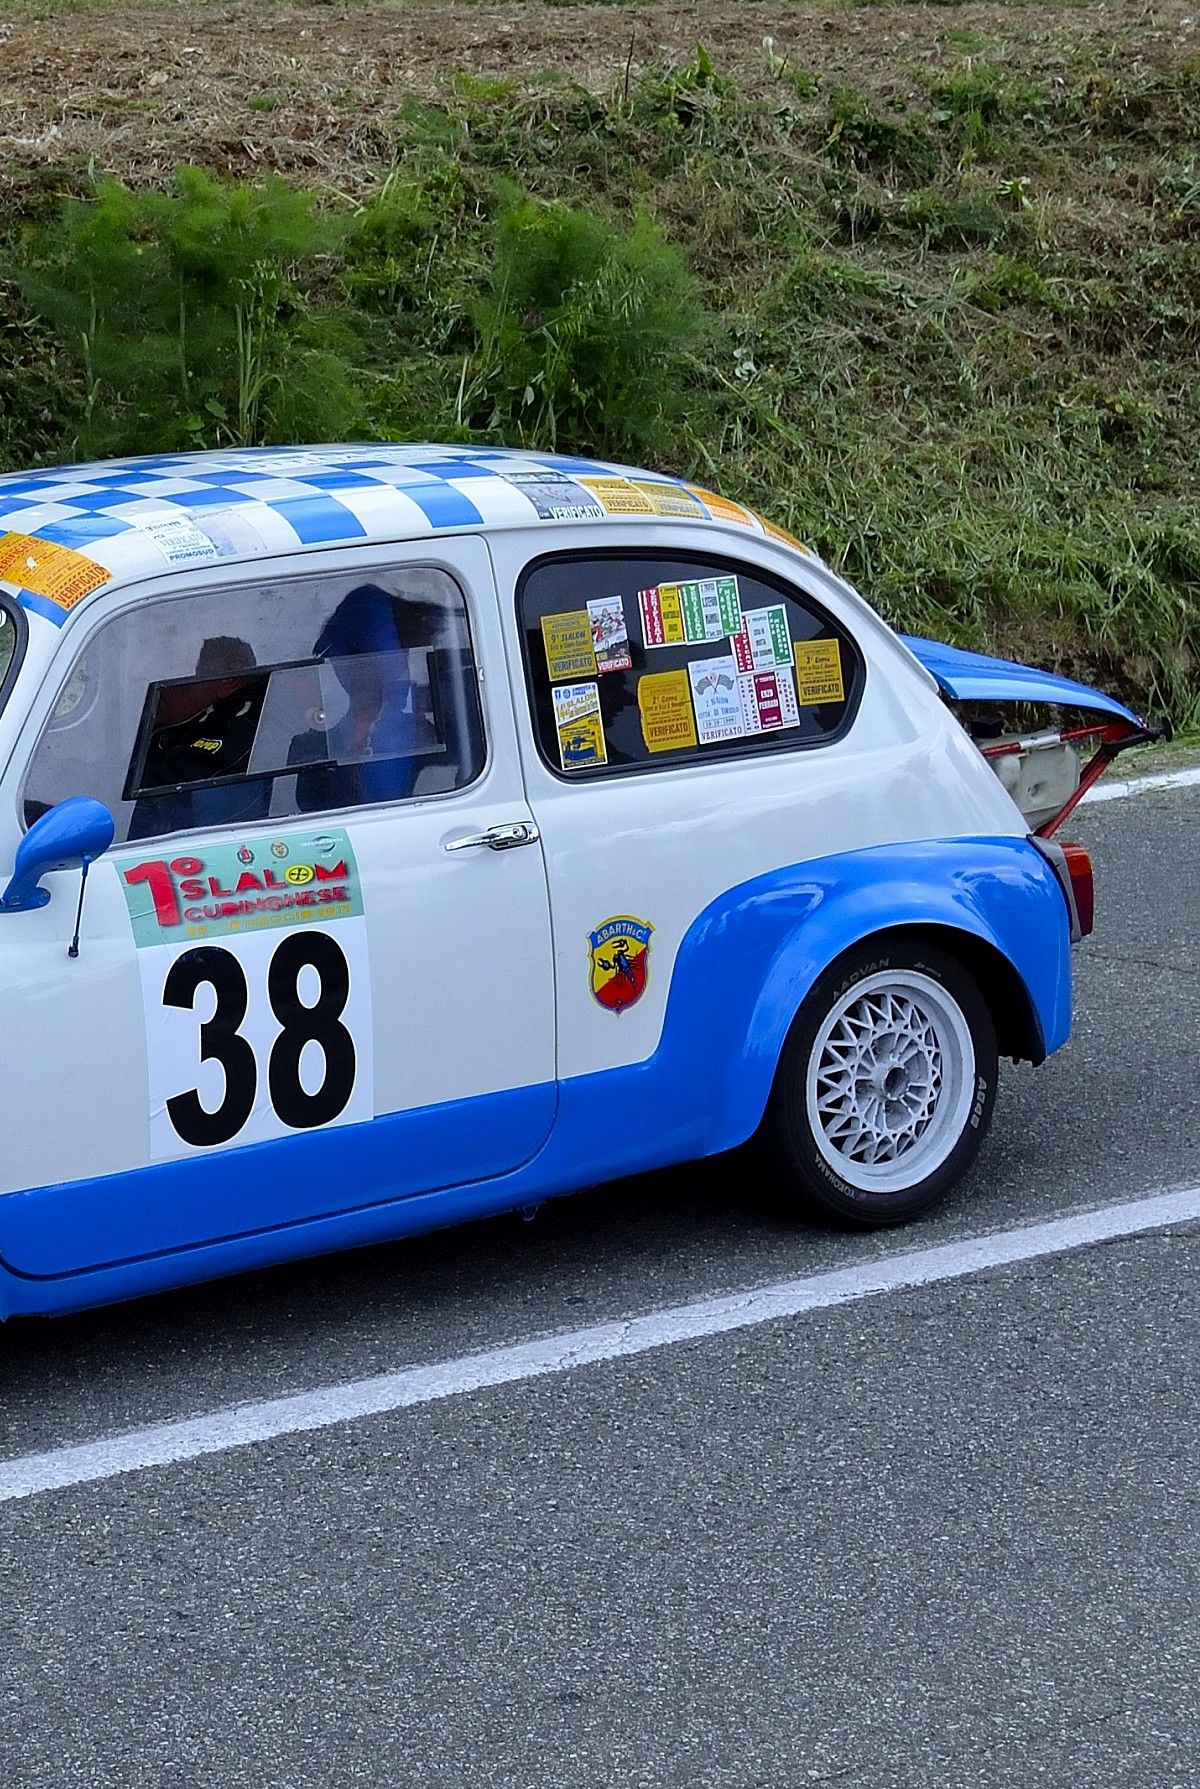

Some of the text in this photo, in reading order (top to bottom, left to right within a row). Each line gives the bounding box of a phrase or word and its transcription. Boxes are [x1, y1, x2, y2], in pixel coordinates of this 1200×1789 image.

[549, 505, 604, 519] VERIFICATO
[169, 549, 214, 561] PROMOSUD
[54, 566, 107, 604] VERIFICATO
[598, 658, 629, 670] VERIFICATO
[802, 683, 840, 696] VERIFICATO
[648, 722, 688, 738] VERIFICATO
[701, 726, 742, 740] VERIFICATO
[180, 859, 348, 900] SLALOM
[840, 957, 890, 990] ADVAN
[161, 929, 358, 1148] 38
[815, 1153, 855, 1200] YOKOHAMA
